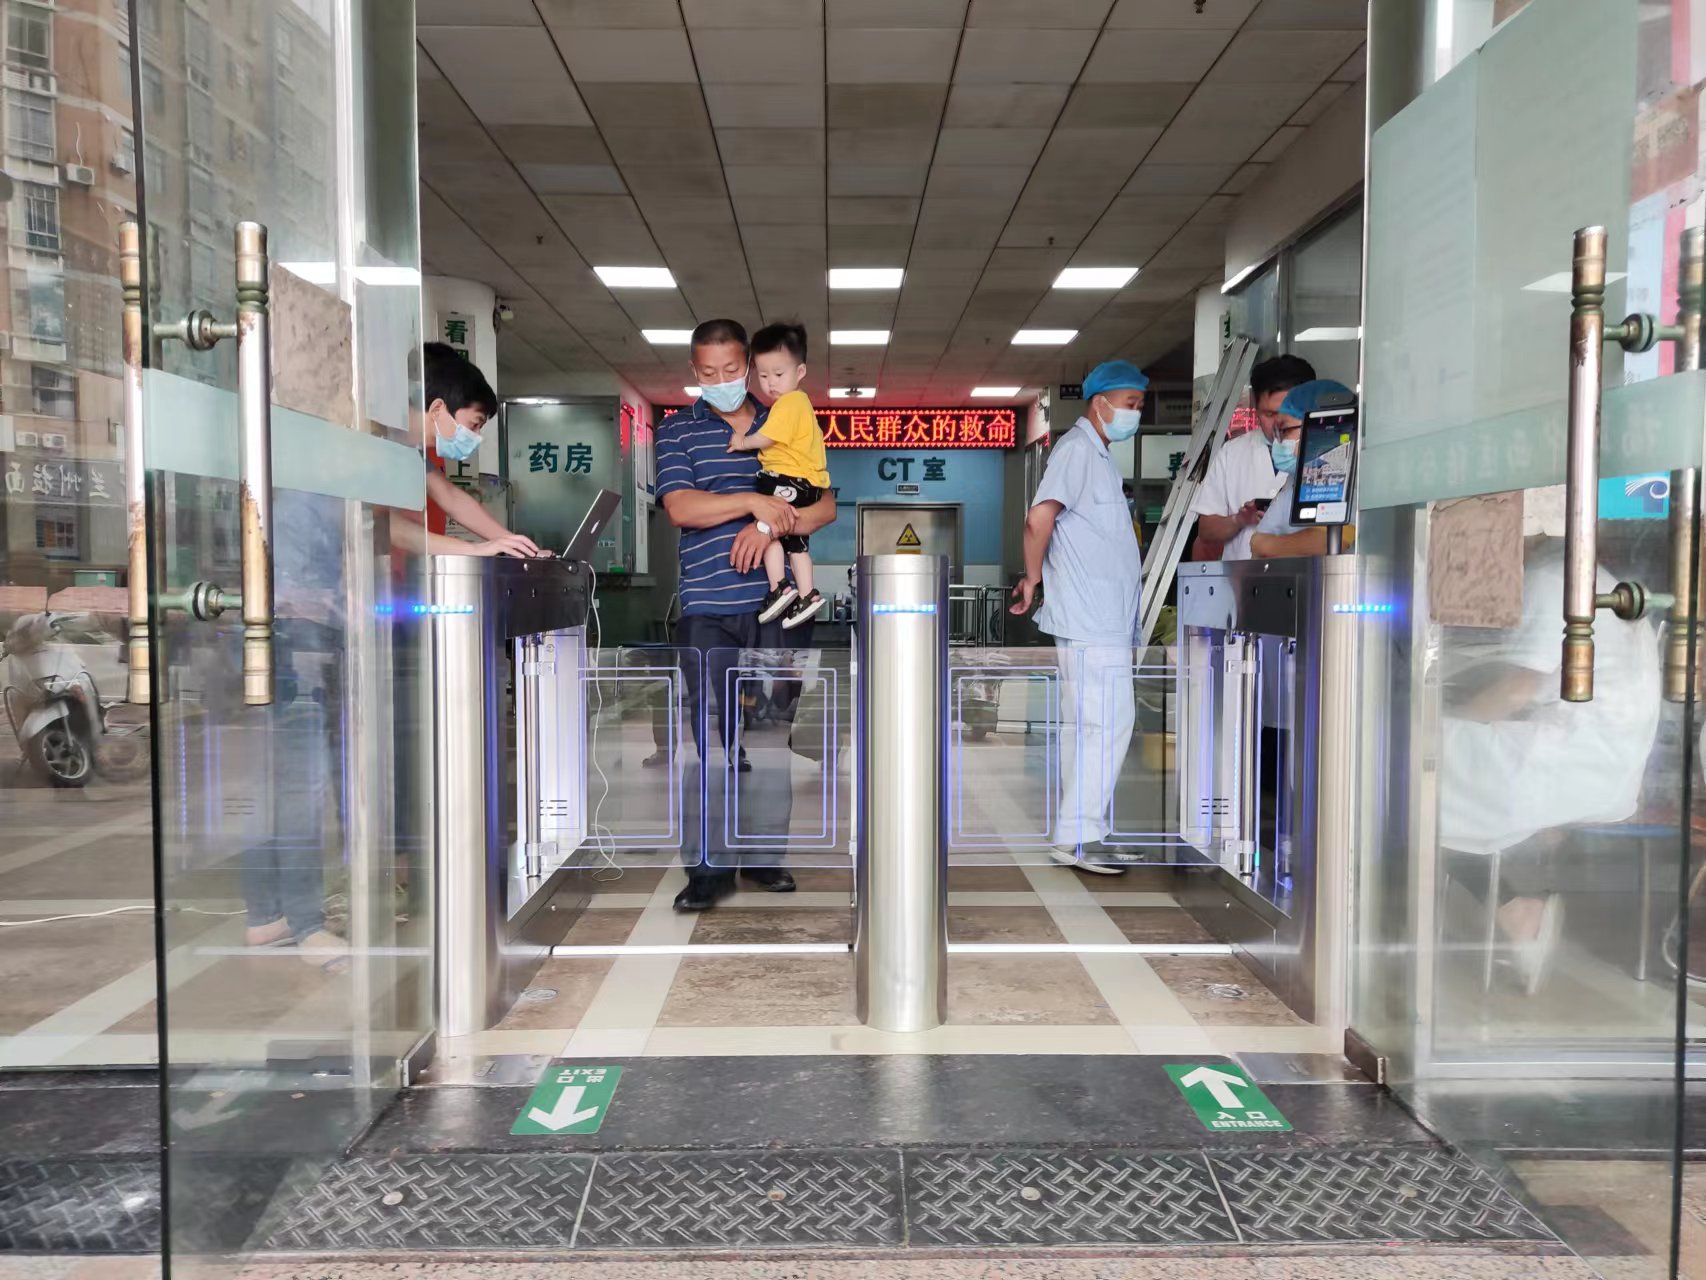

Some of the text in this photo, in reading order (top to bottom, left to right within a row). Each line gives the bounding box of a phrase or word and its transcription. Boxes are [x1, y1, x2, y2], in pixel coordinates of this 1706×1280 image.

[823, 414, 1012, 442] 人民群众的救命
[528, 442, 593, 473] 药房
[1211, 1120, 1284, 1128] ENTRANCE
[1217, 1111, 1267, 1119] 入口
